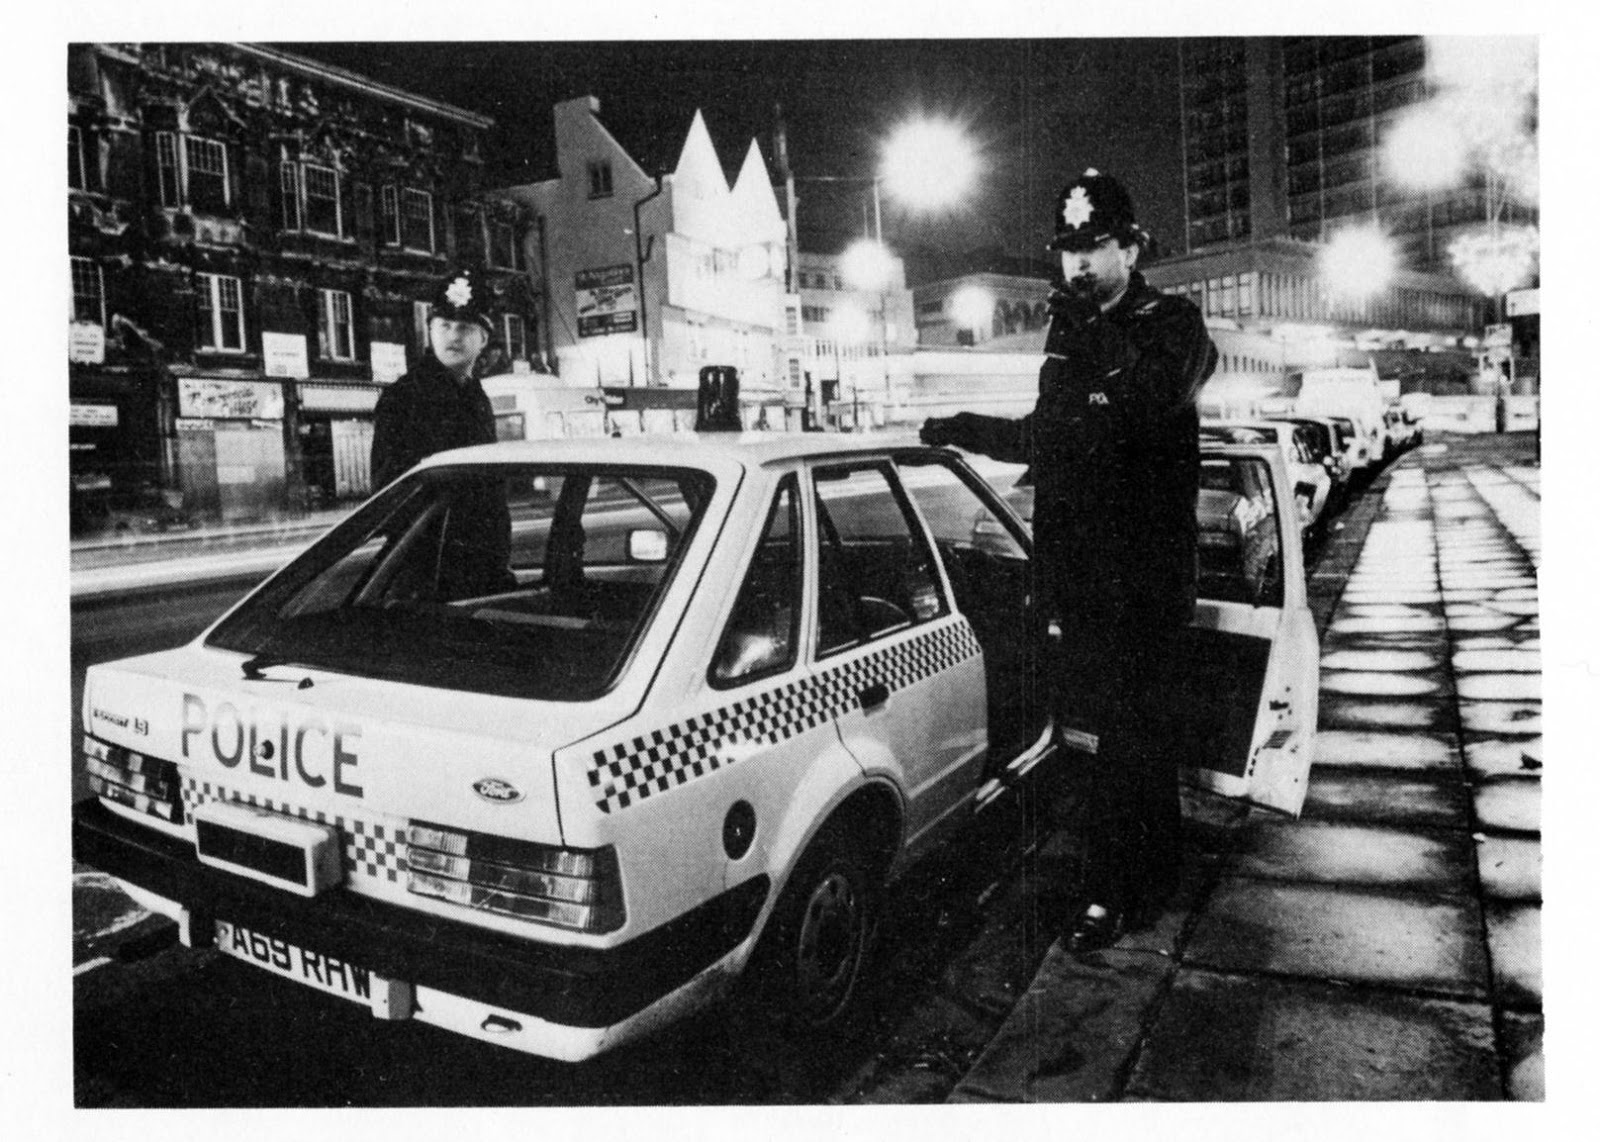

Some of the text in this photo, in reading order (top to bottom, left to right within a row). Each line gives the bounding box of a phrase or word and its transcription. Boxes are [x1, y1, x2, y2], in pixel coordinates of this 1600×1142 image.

[182, 693, 363, 799] POLICE
[480, 781, 511, 799] Ford
[233, 926, 371, 1000] A69 RHW
